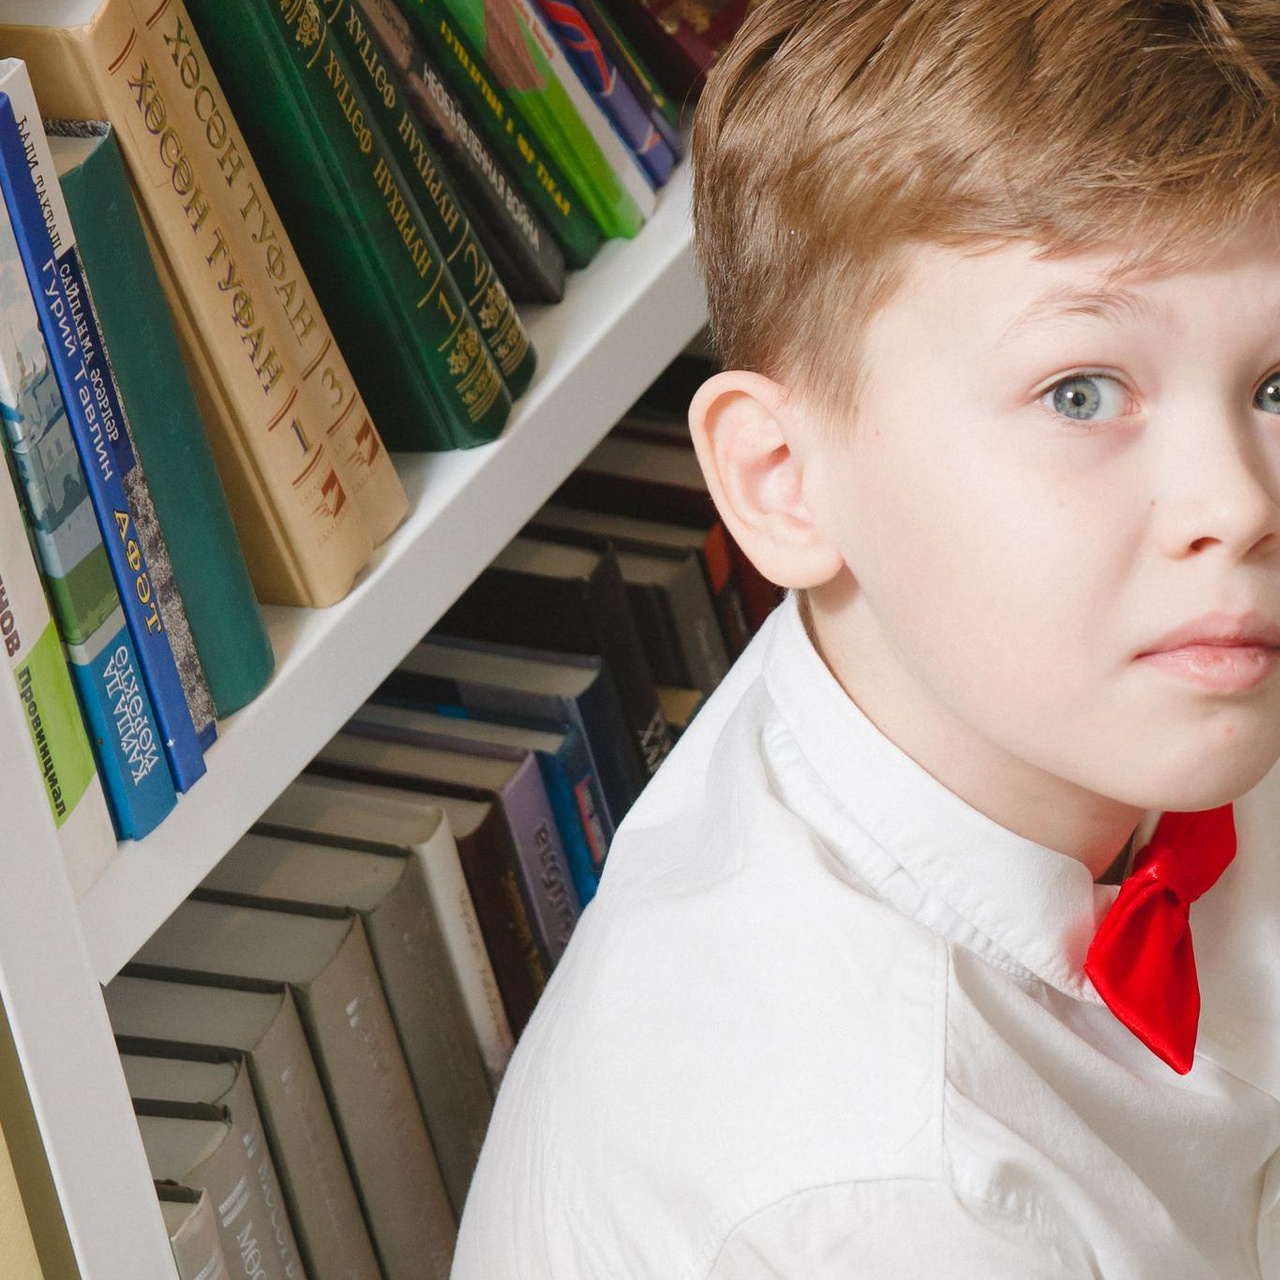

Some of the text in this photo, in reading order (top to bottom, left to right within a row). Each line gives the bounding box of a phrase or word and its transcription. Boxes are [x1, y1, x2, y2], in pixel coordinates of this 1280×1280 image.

[325, 49, 373, 154] ФӘТТАХ
[345, 5, 396, 110] ФӘТТАХ
[31, 175, 61, 251] ТАКТАШ
[162, 16, 318, 347] ХӘСӘН ТУФАН
[374, 156, 432, 279] НУРИХАН
[397, 111, 460, 232] НУРИХАН
[423, 65, 540, 255] НЕОБЪЯВЛЕННАЯ ВОЙНА
[128, 59, 285, 396] ХӘСӘН ТУФАН
[40, 257, 113, 481] Гурий Тавлин
[58, 263, 119, 440] САЙЛАНМА ӘСӘРЛӘР
[431, 289, 458, 326] 1
[286, 415, 315, 454] 1
[320, 368, 346, 409] 3
[0, 575, 21, 658] НОВ
[114, 510, 163, 634] АФӘТ
[18, 665, 67, 818] Провинциал
[103, 656, 149, 786] КАЙДА ДА
[115, 645, 160, 773] ЙӨРӘКТӘ
